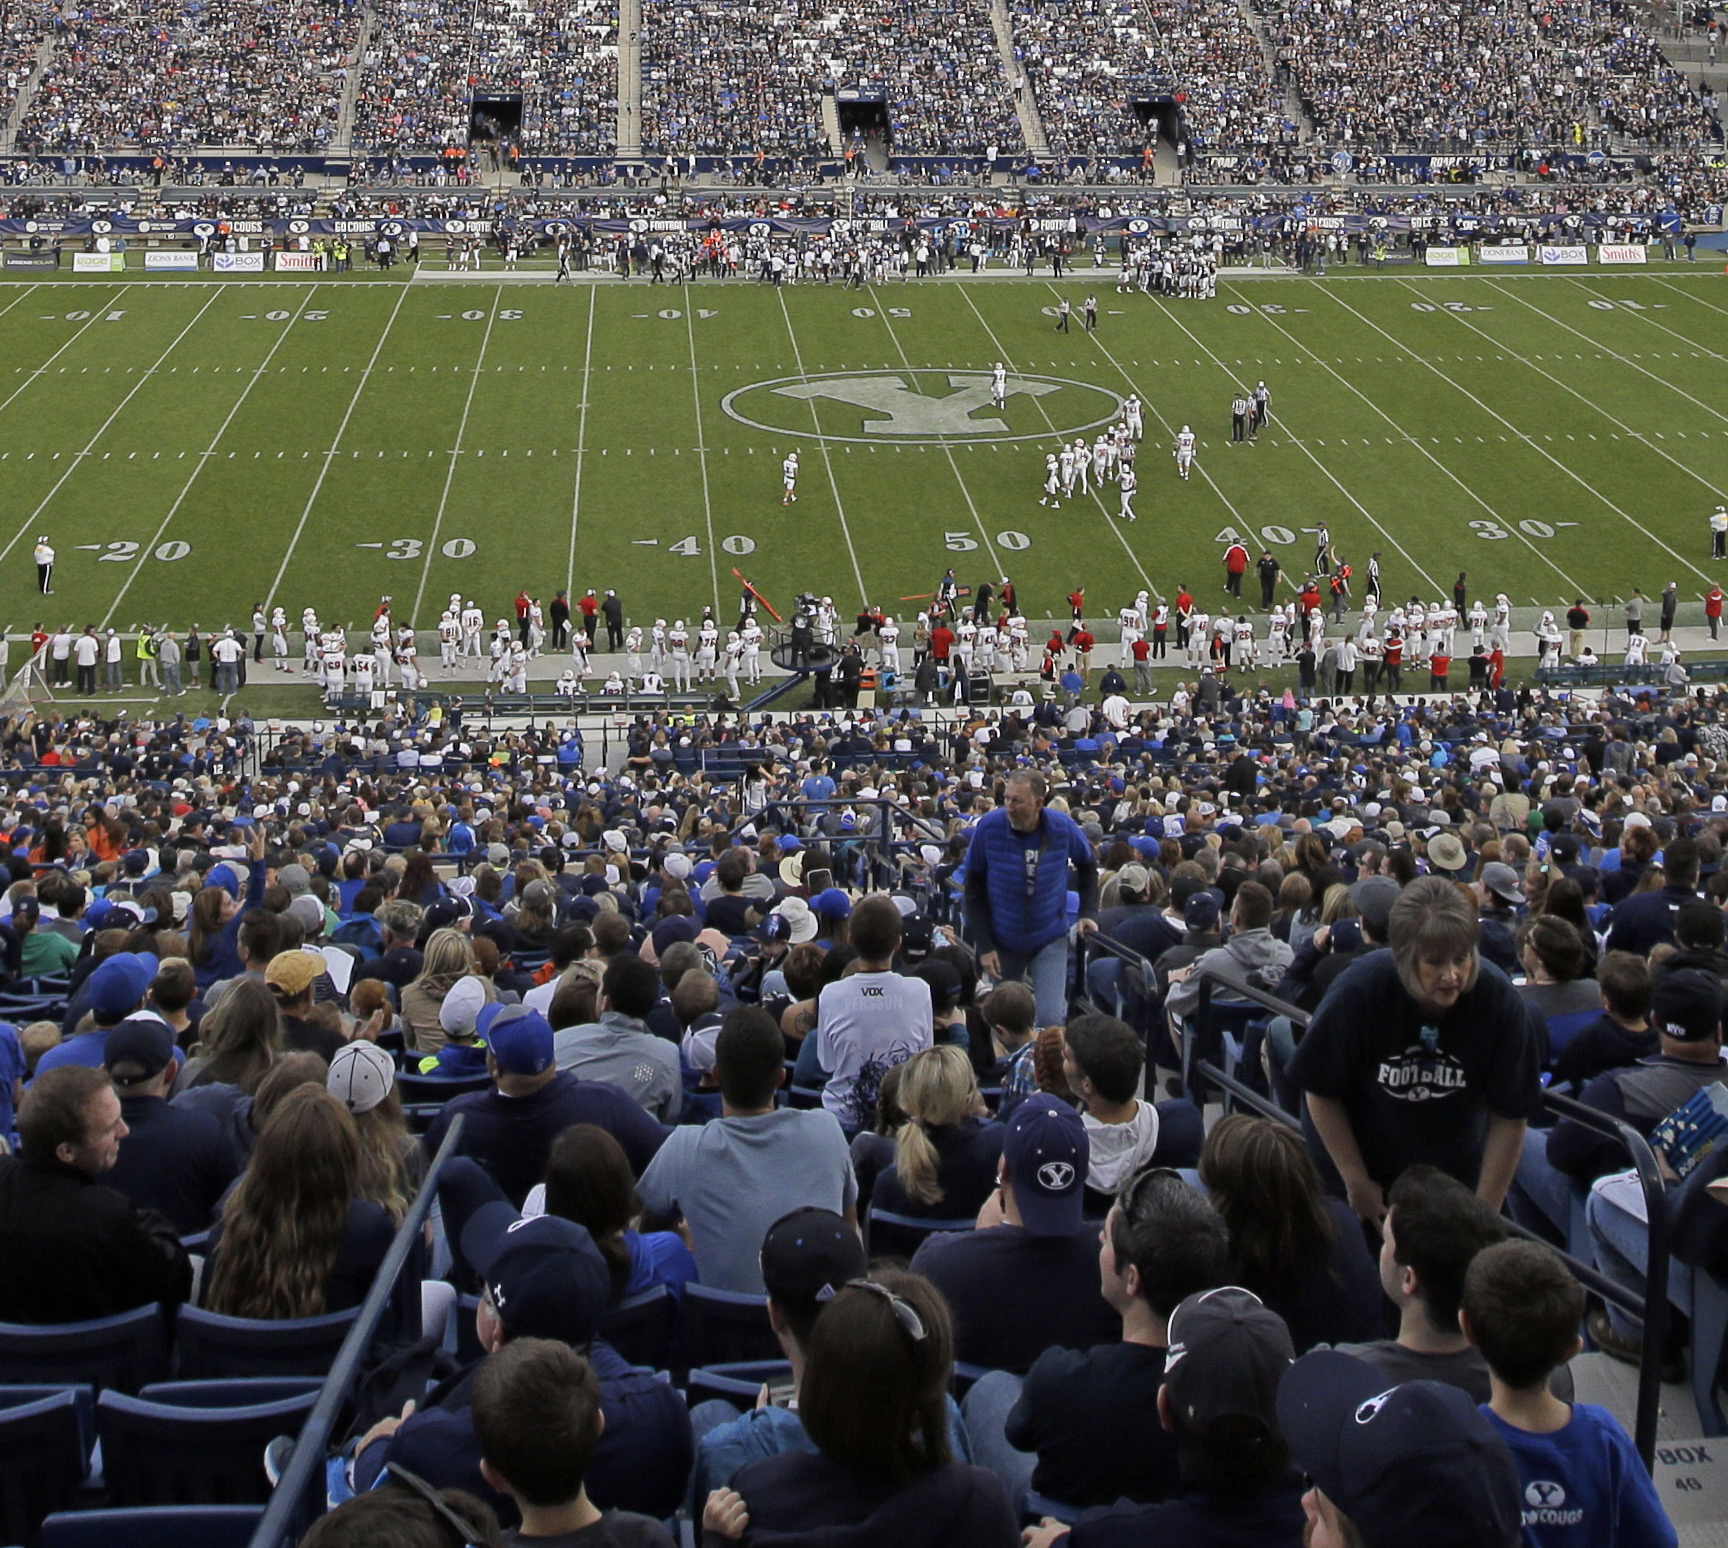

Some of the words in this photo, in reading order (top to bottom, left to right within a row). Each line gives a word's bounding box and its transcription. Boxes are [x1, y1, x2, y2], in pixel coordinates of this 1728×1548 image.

[233, 221, 263, 233] COUGS
[335, 221, 346, 232] GO
[348, 221, 375, 232] COUGS
[147, 254, 171, 263] ZIONS
[173, 254, 195, 263] BANK
[235, 256, 262, 265] BOX
[1560, 250, 1584, 259] BOX
[1603, 247, 1641, 260] Smith's
[1466, 518, 1558, 540] 30
[669, 535, 757, 557] 40
[944, 530, 1032, 552] 50
[98, 540, 192, 562] 20
[386, 538, 477, 560] 30
[357, 662, 370, 672] 54
[861, 987, 884, 997] VOX
[1378, 1063, 1466, 1089] FOOTBALL
[1657, 1446, 1712, 1465] BOX
[1675, 1477, 1703, 1492] 4G
